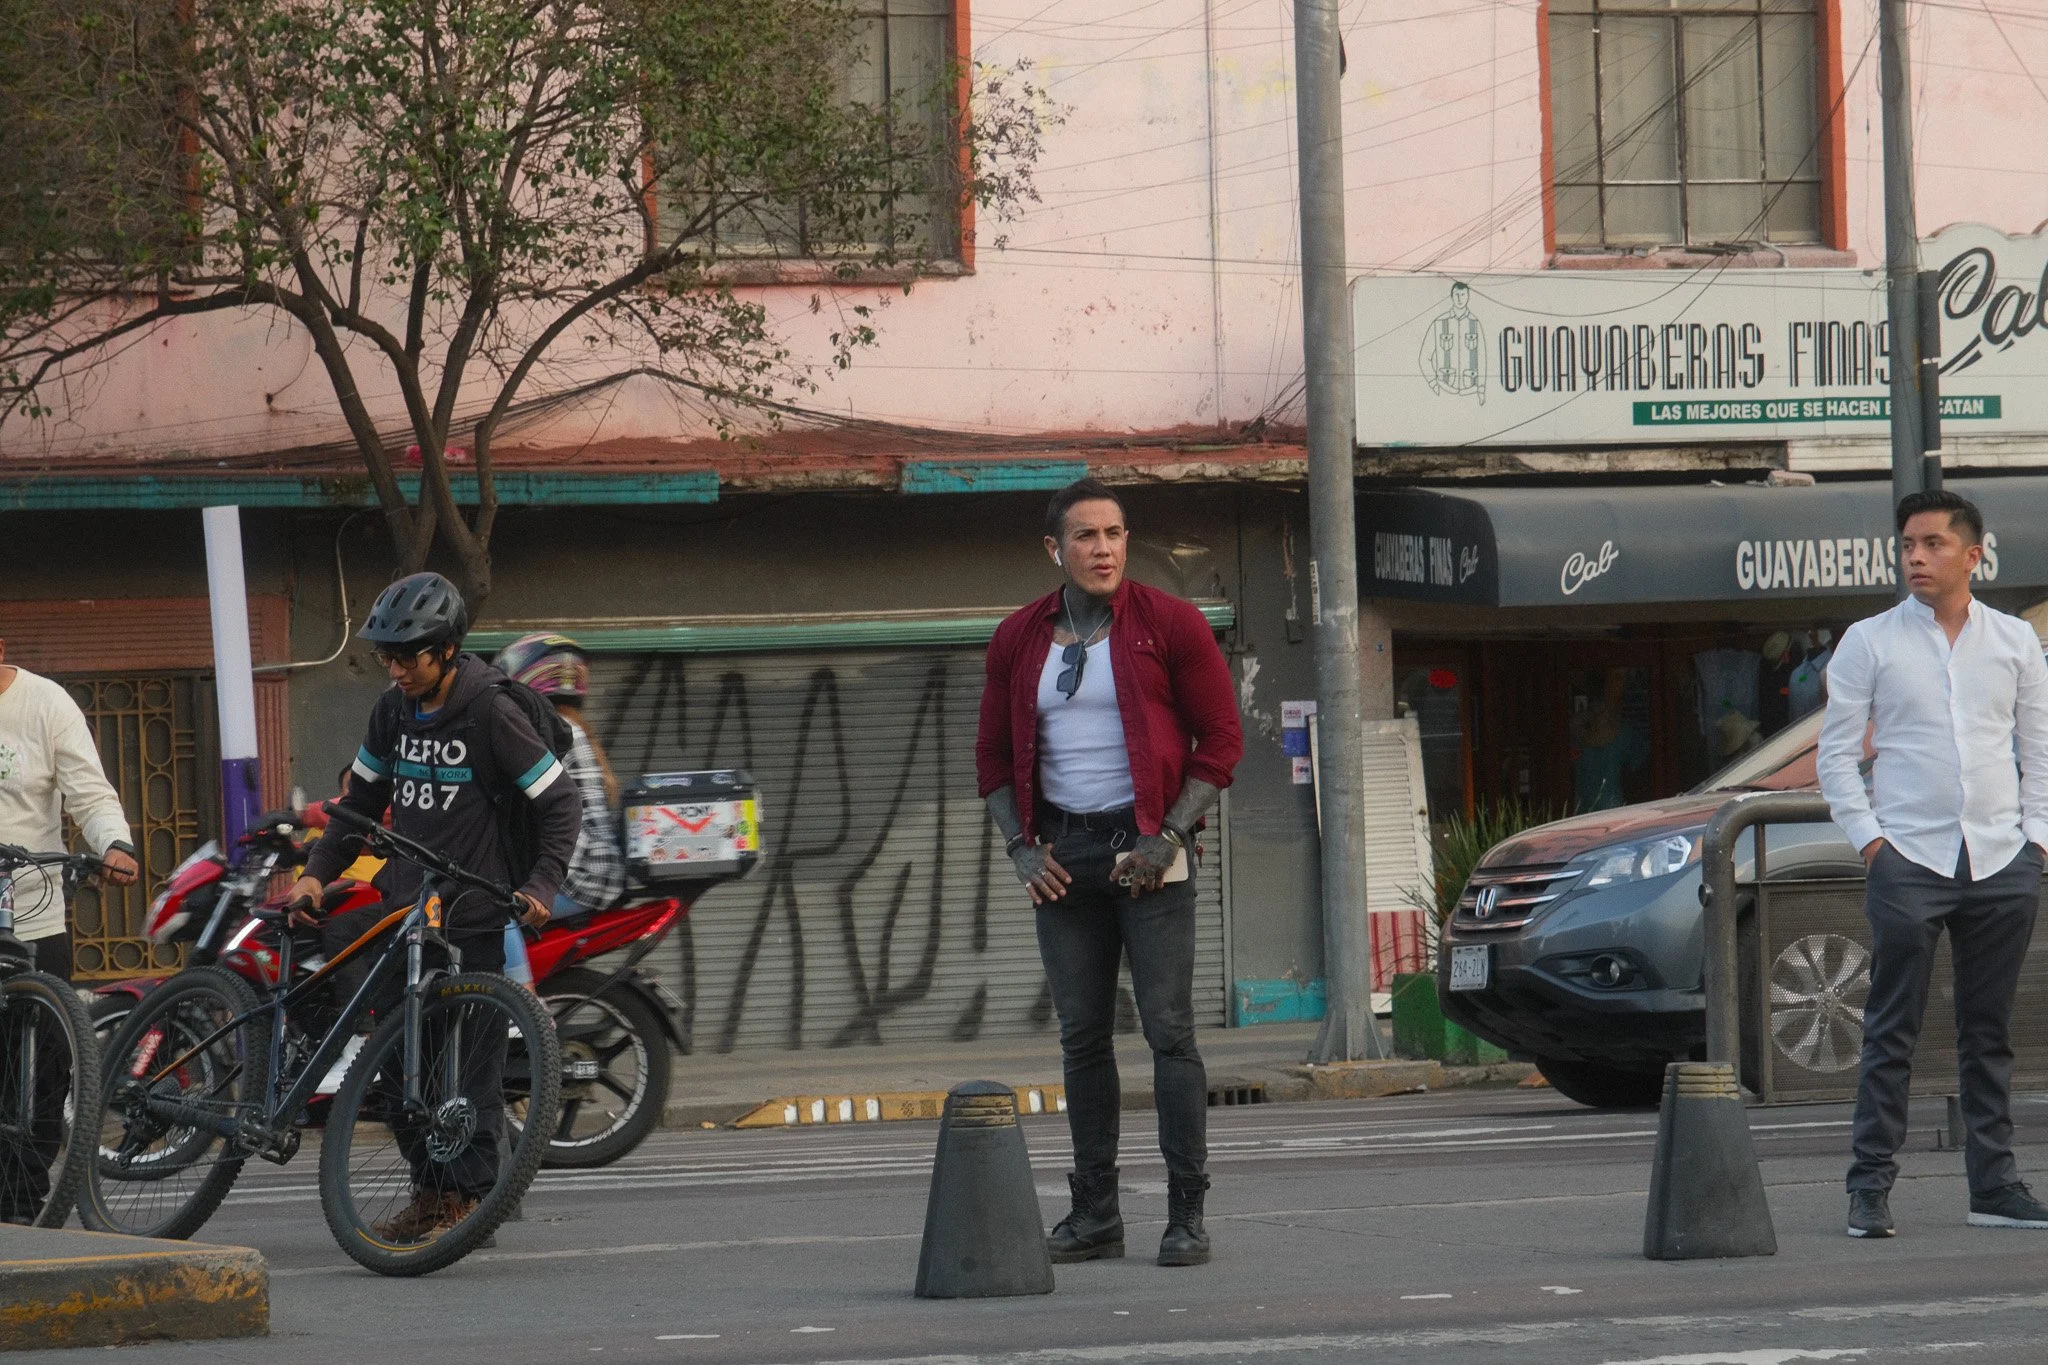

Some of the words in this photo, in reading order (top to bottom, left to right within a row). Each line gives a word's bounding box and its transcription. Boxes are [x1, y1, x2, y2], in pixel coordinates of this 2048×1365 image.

[1499, 323, 1765, 393] GUAYABERAS
[1651, 404, 1682, 421] LAS
[1686, 403, 1762, 420] MEJORES
[1765, 402, 1799, 420] QUE
[1803, 401, 1823, 418] SE
[1826, 400, 1881, 416] HACEN
[1560, 540, 1619, 595] Cab
[440, 769, 469, 780] YORK
